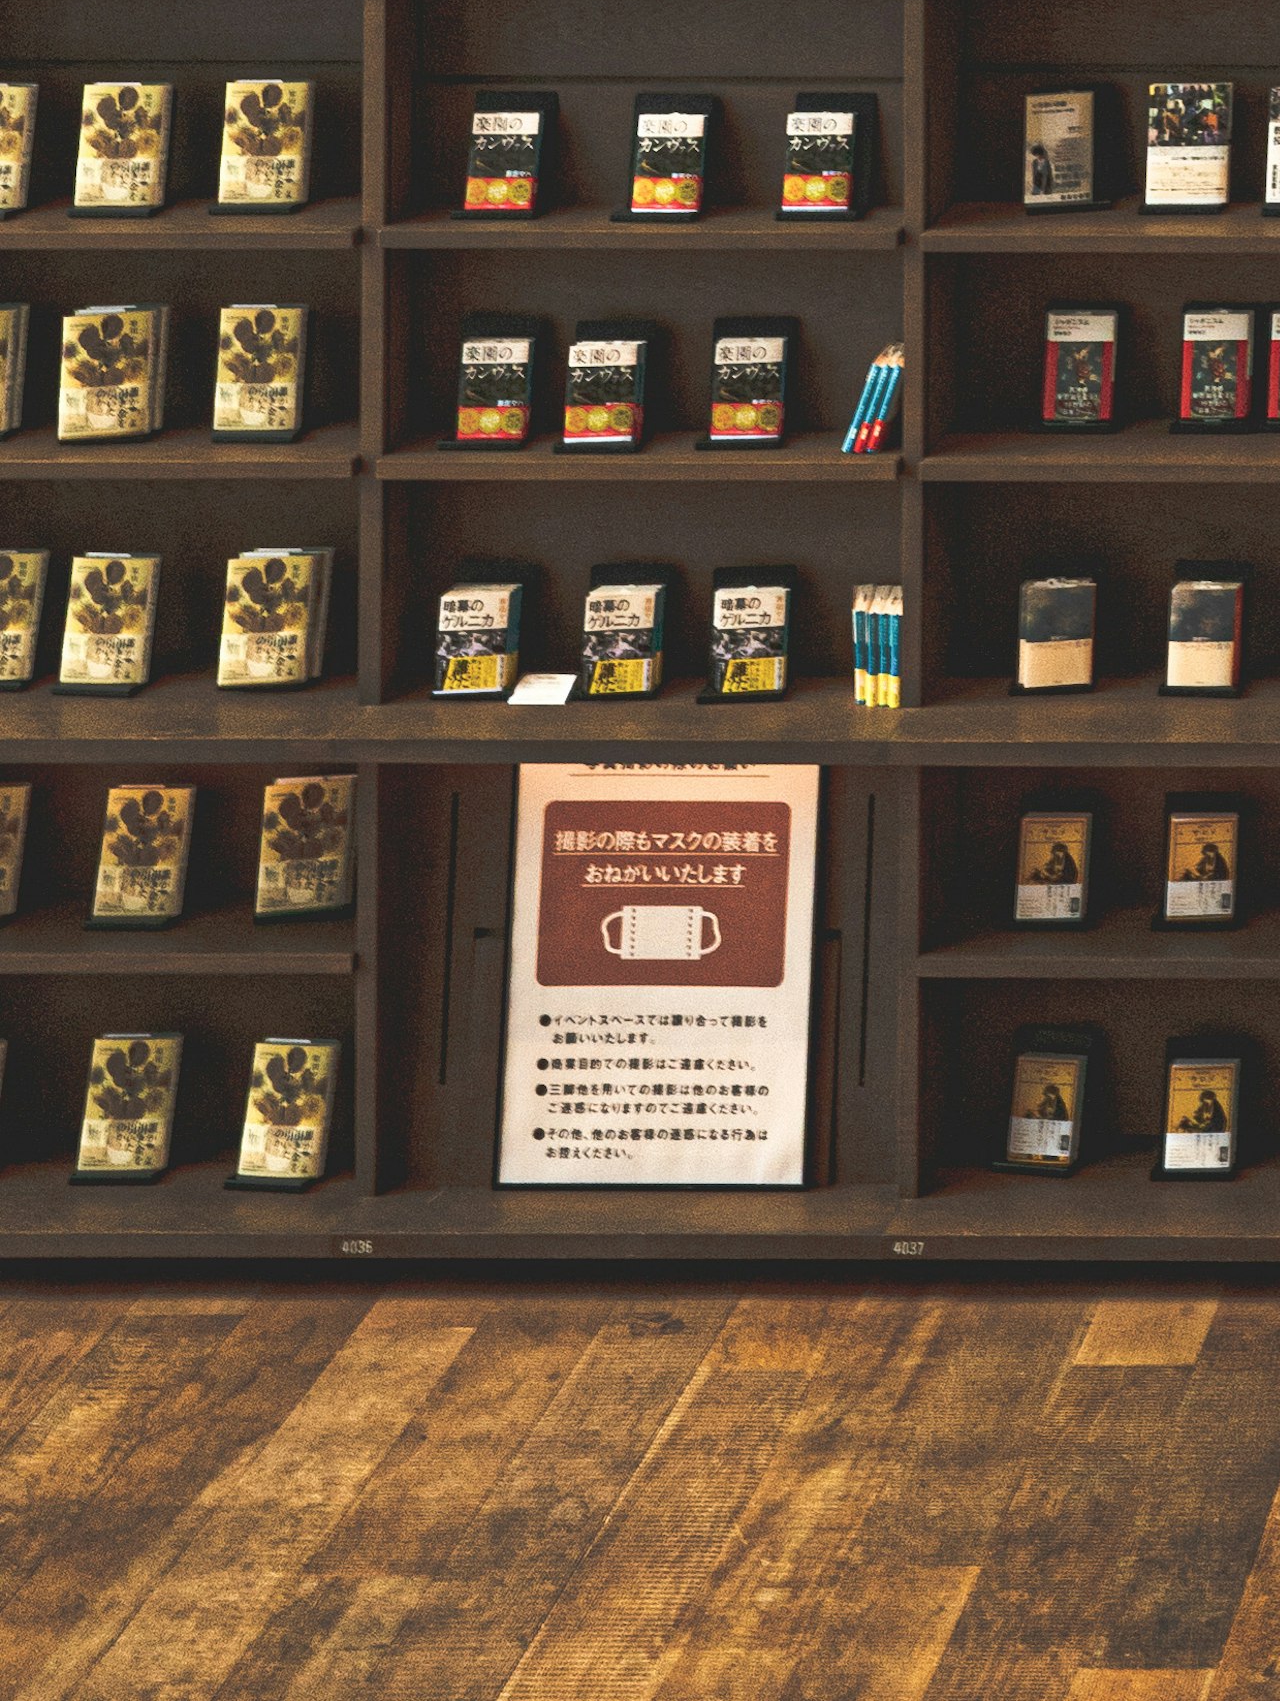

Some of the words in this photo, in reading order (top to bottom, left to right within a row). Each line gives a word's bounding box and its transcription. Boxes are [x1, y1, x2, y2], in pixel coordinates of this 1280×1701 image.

[555, 830, 778, 853] 撮影の際もマスクの装着を
[585, 863, 747, 885] おねがいいたします
[342, 1240, 374, 1254] 4036
[893, 1241, 925, 1255] 4037
